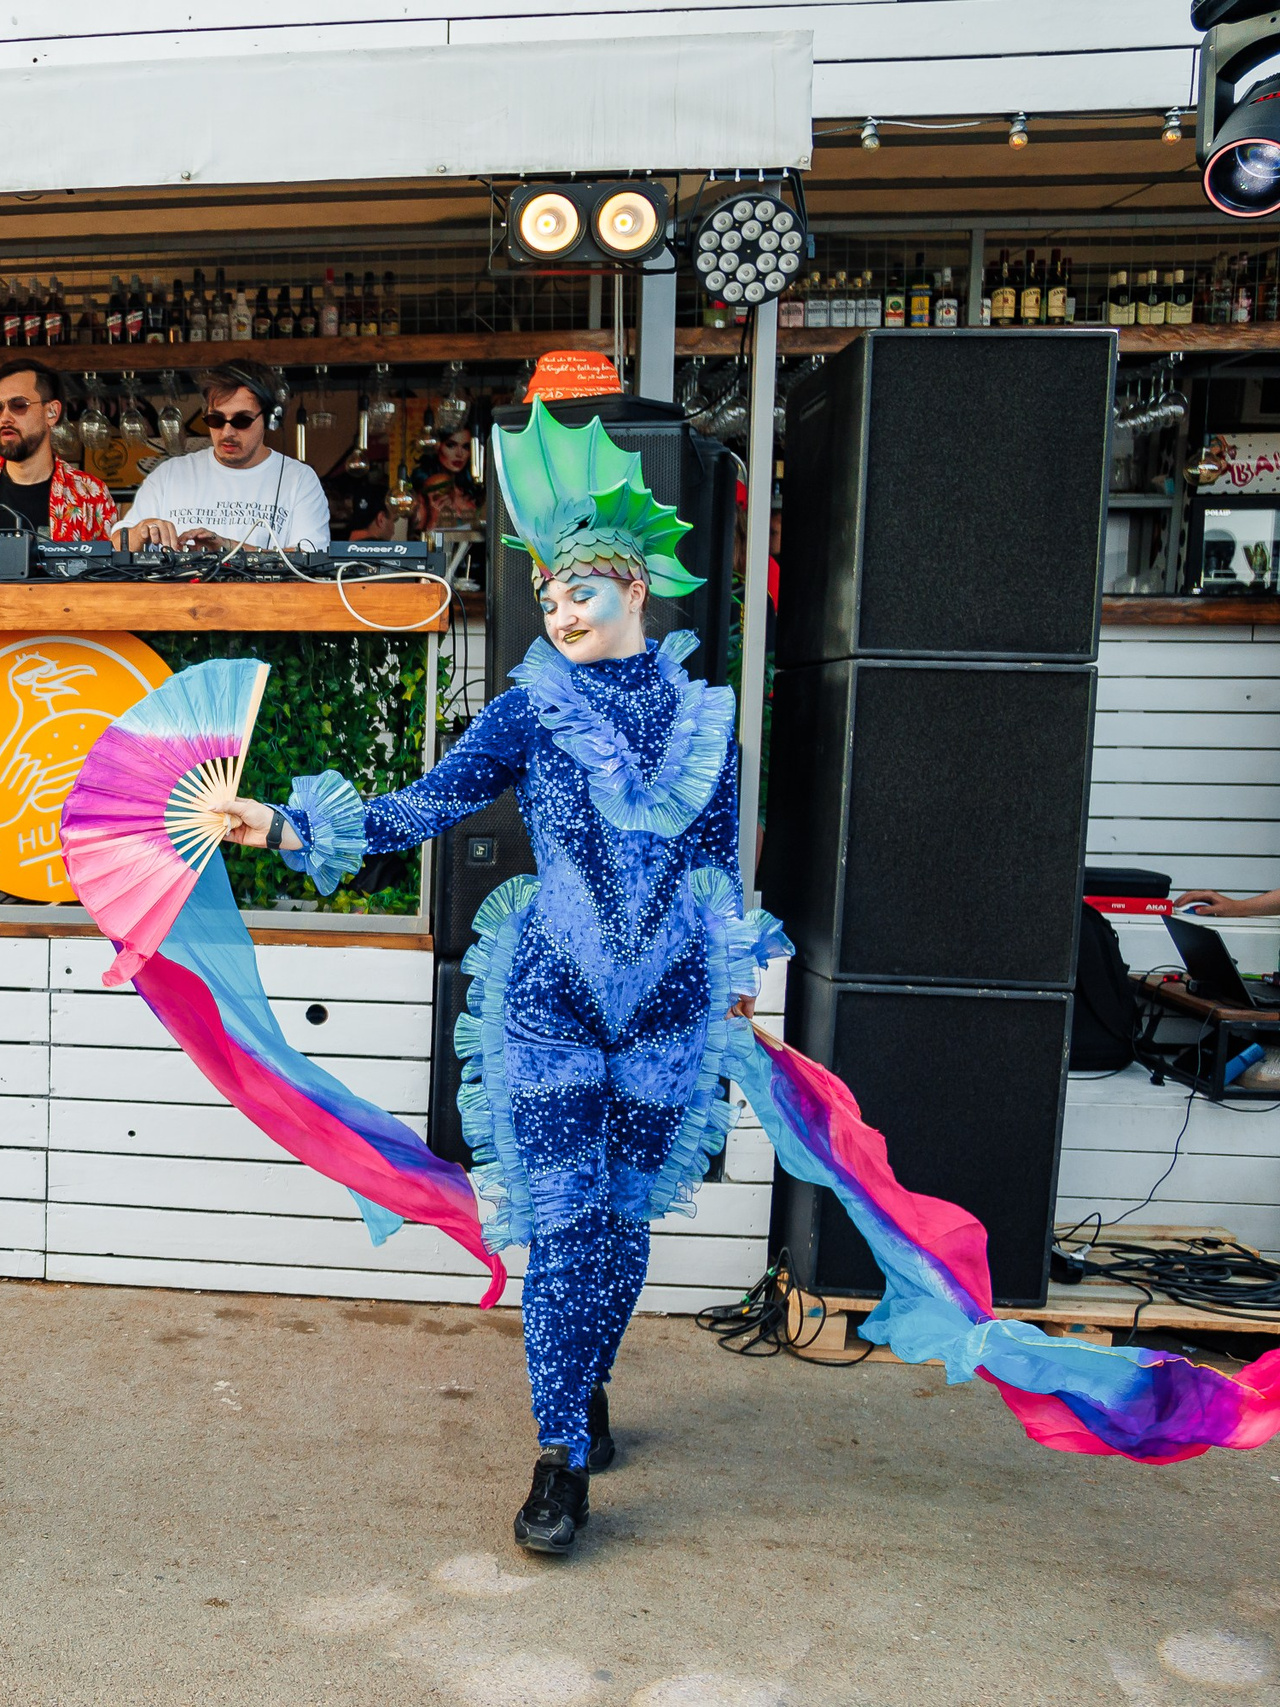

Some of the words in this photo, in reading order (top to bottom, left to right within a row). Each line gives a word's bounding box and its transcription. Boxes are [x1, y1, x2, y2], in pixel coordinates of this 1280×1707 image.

[170, 508, 193, 518] FUCK
[195, 508, 218, 517] THE
[220, 509, 245, 517] MASS
[216, 501, 242, 509] FUCK
[245, 502, 289, 518] POLITCS
[177, 517, 203, 525] FUCK
[206, 517, 226, 525] THE
[347, 544, 393, 553] Pioneer
